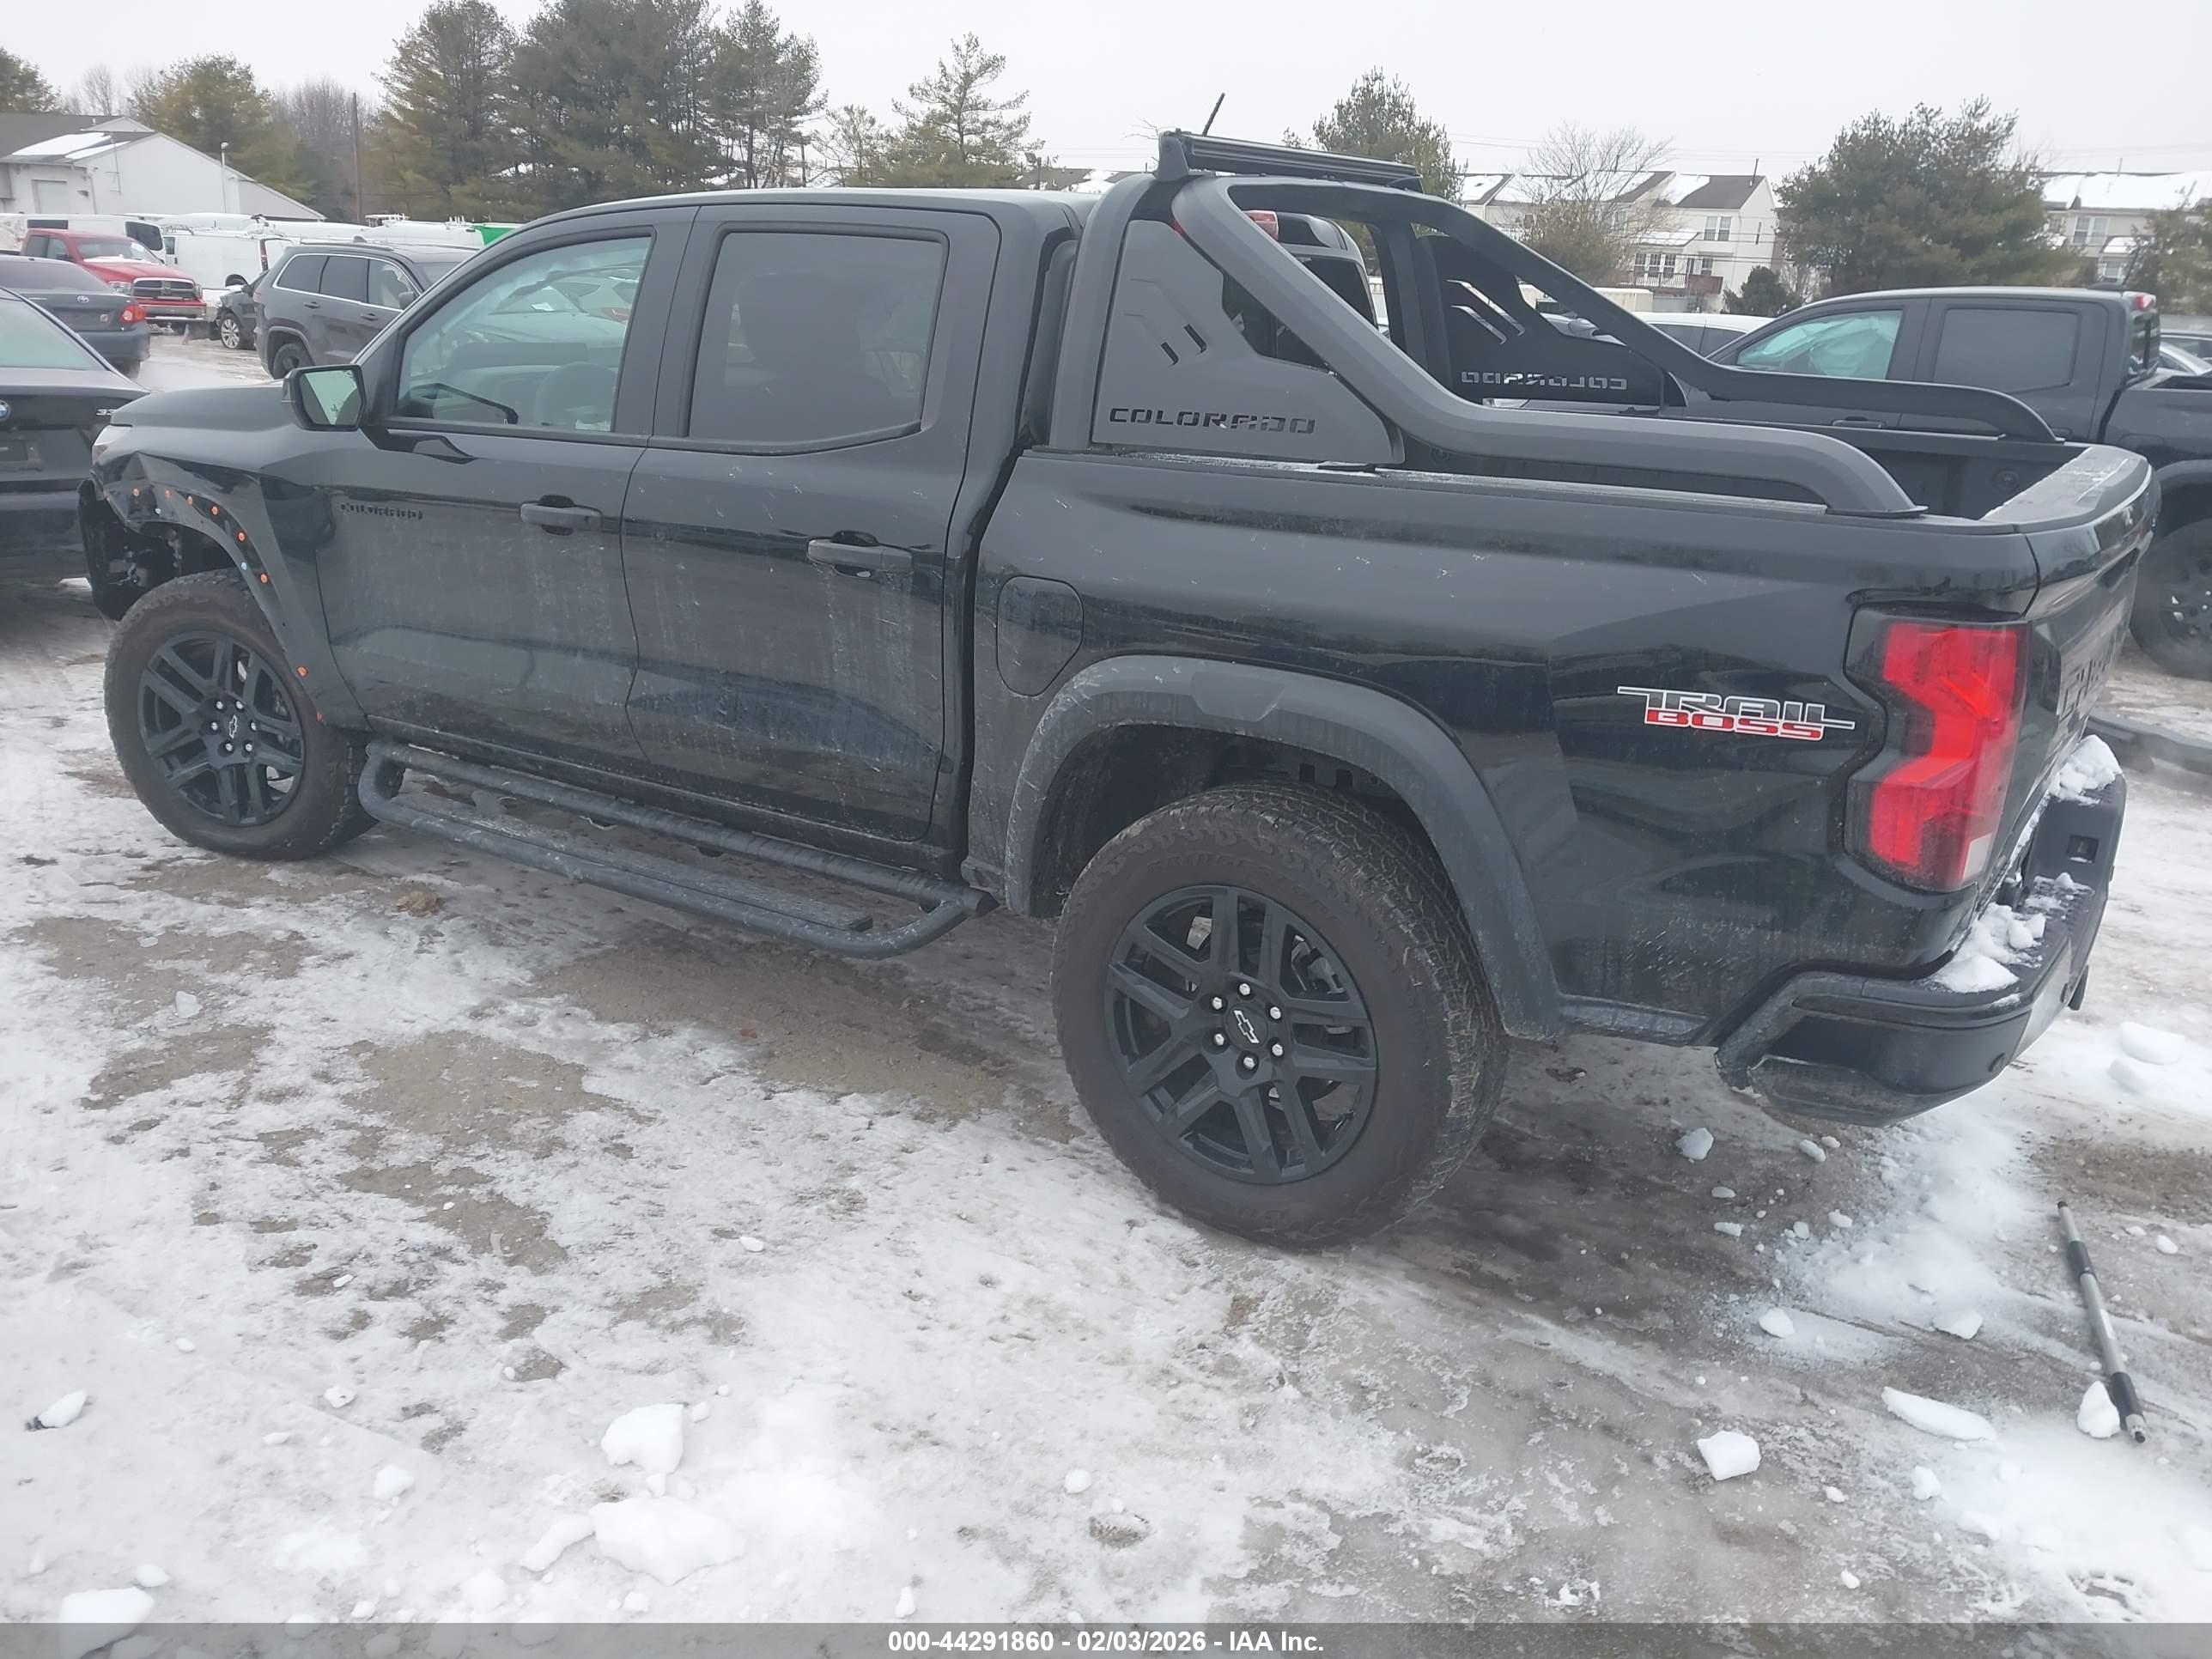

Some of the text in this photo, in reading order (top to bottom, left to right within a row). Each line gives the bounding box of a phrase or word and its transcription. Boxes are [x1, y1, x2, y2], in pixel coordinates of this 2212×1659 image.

[1109, 407, 1317, 434] COLORADO
[1617, 685, 1856, 730] TRAIL
[1644, 708, 1825, 741] BOSS
